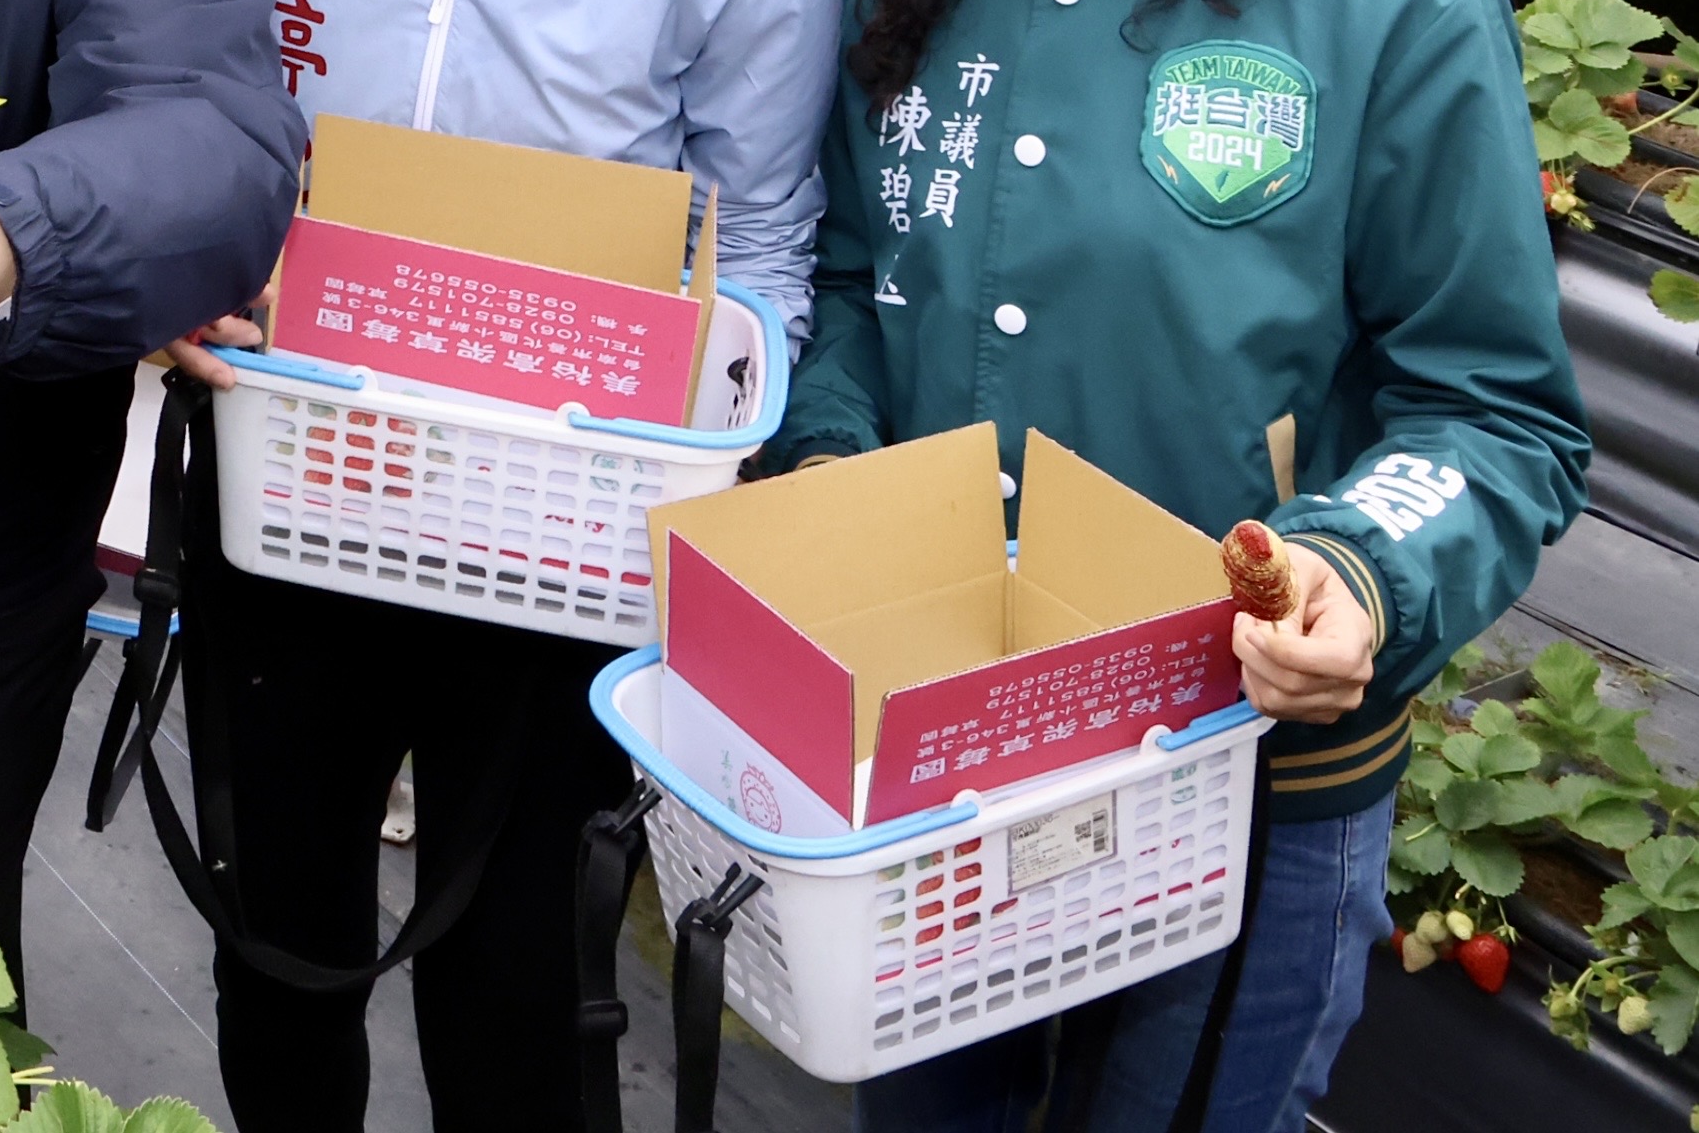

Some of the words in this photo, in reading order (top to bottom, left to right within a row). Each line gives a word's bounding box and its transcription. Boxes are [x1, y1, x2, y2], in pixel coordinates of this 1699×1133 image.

[1165, 55, 1221, 85] TEAM
[1222, 55, 1302, 96] TAIWAN
[918, 53, 1001, 229] 市議員
[1152, 81, 1308, 153] 挺台灣
[1187, 131, 1263, 171] 2024
[393, 277, 575, 326] 0928-701579
[395, 264, 577, 312] 0935-055678
[315, 307, 642, 396] 美裕高架草莓園
[985, 656, 1151, 710] 0928-701579
[988, 643, 1153, 697] 0935-055678
[909, 681, 1205, 785] 美裕高架草莓園
